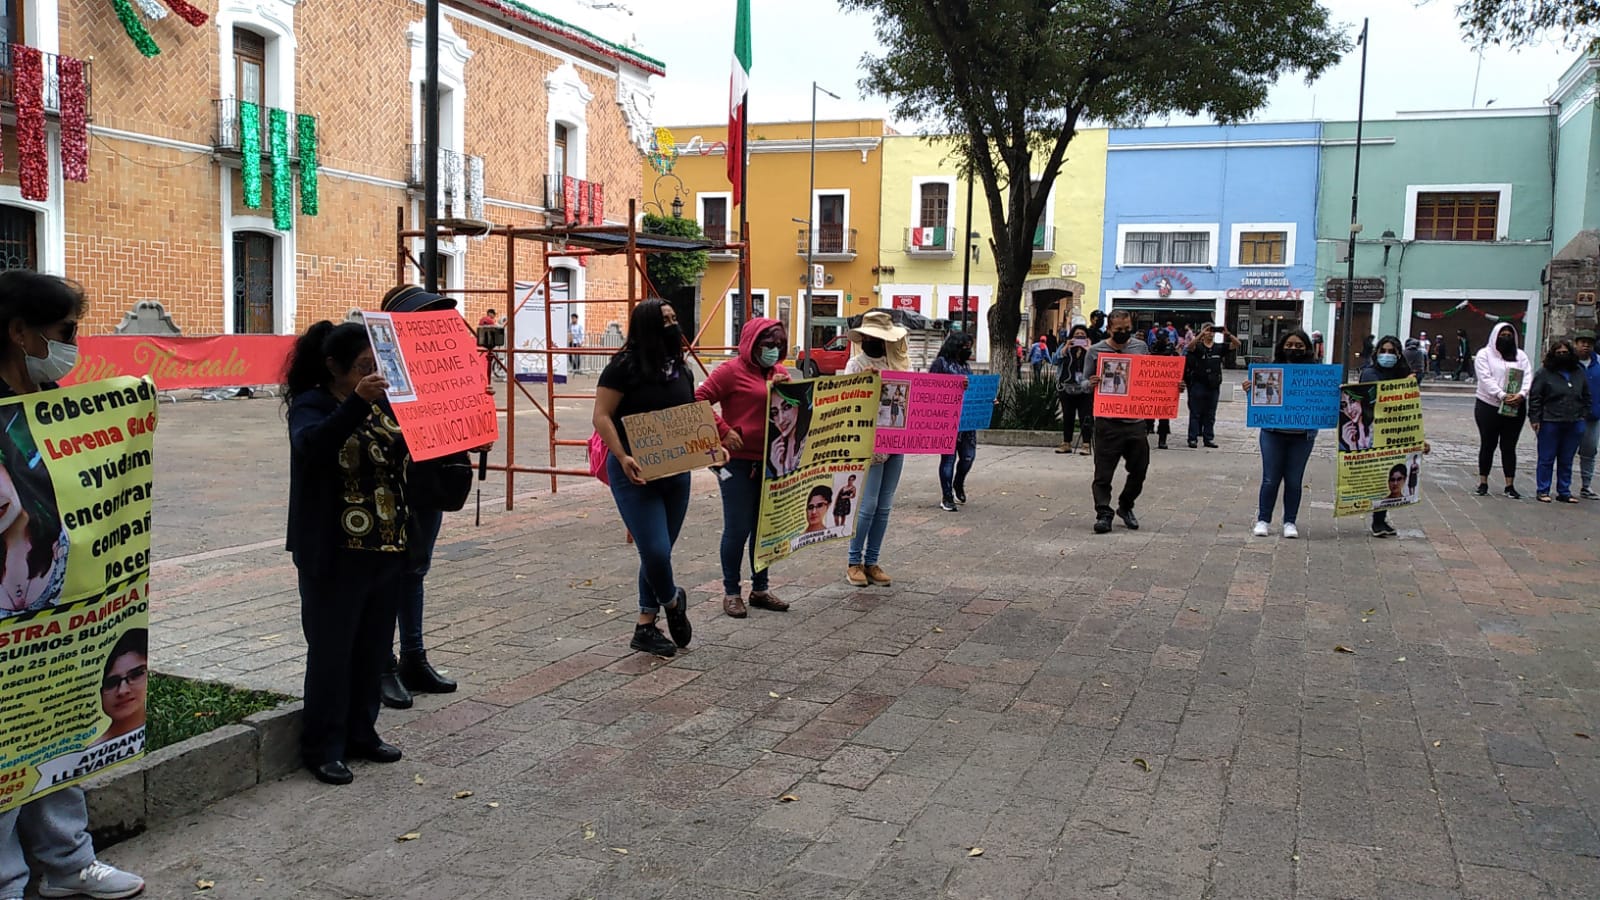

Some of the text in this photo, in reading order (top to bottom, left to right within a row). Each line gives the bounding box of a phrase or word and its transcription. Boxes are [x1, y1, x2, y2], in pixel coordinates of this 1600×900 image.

[1241, 278, 1290, 286] SANTA RAQUEL
[406, 317, 464, 337] PRESIDENTE
[415, 338, 457, 354] AMLO
[134, 342, 251, 379] Tlaxcala
[409, 353, 479, 377] AYUDAME A
[1138, 370, 1181, 378] AYUDANOS
[417, 373, 487, 395] NCONTRAR A
[817, 375, 874, 391] Gobernadora
[1291, 379, 1339, 387] AYUDANOS
[449, 393, 490, 411] DOCENTE
[814, 388, 874, 407] Lorena Cuéllar
[1379, 393, 1403, 403] Lorena
[910, 408, 959, 418] AYUDAME A
[1383, 403, 1415, 413] ayúdame
[435, 417, 468, 445] MUÑOZ
[468, 409, 495, 438] MUÑOZ
[857, 419, 873, 427] mi
[910, 420, 957, 431] LOCALIZAR A
[1374, 415, 1412, 425] encontrar
[44, 424, 123, 460] Lorena
[634, 434, 663, 449] VOCES
[78, 448, 153, 488] ayúdam
[639, 452, 661, 467] NOS
[68, 588, 139, 630] DANIELA
[8, 664, 24, 676] de
[28, 657, 47, 670] 25
[50, 649, 78, 664] años
[81, 644, 96, 654] de
[2, 673, 45, 690] oscuro
[33, 725, 52, 737] usa
[0, 742, 57, 769] septiembre
[51, 745, 135, 785] LLEVARLA
[0, 767, 27, 784] 911
